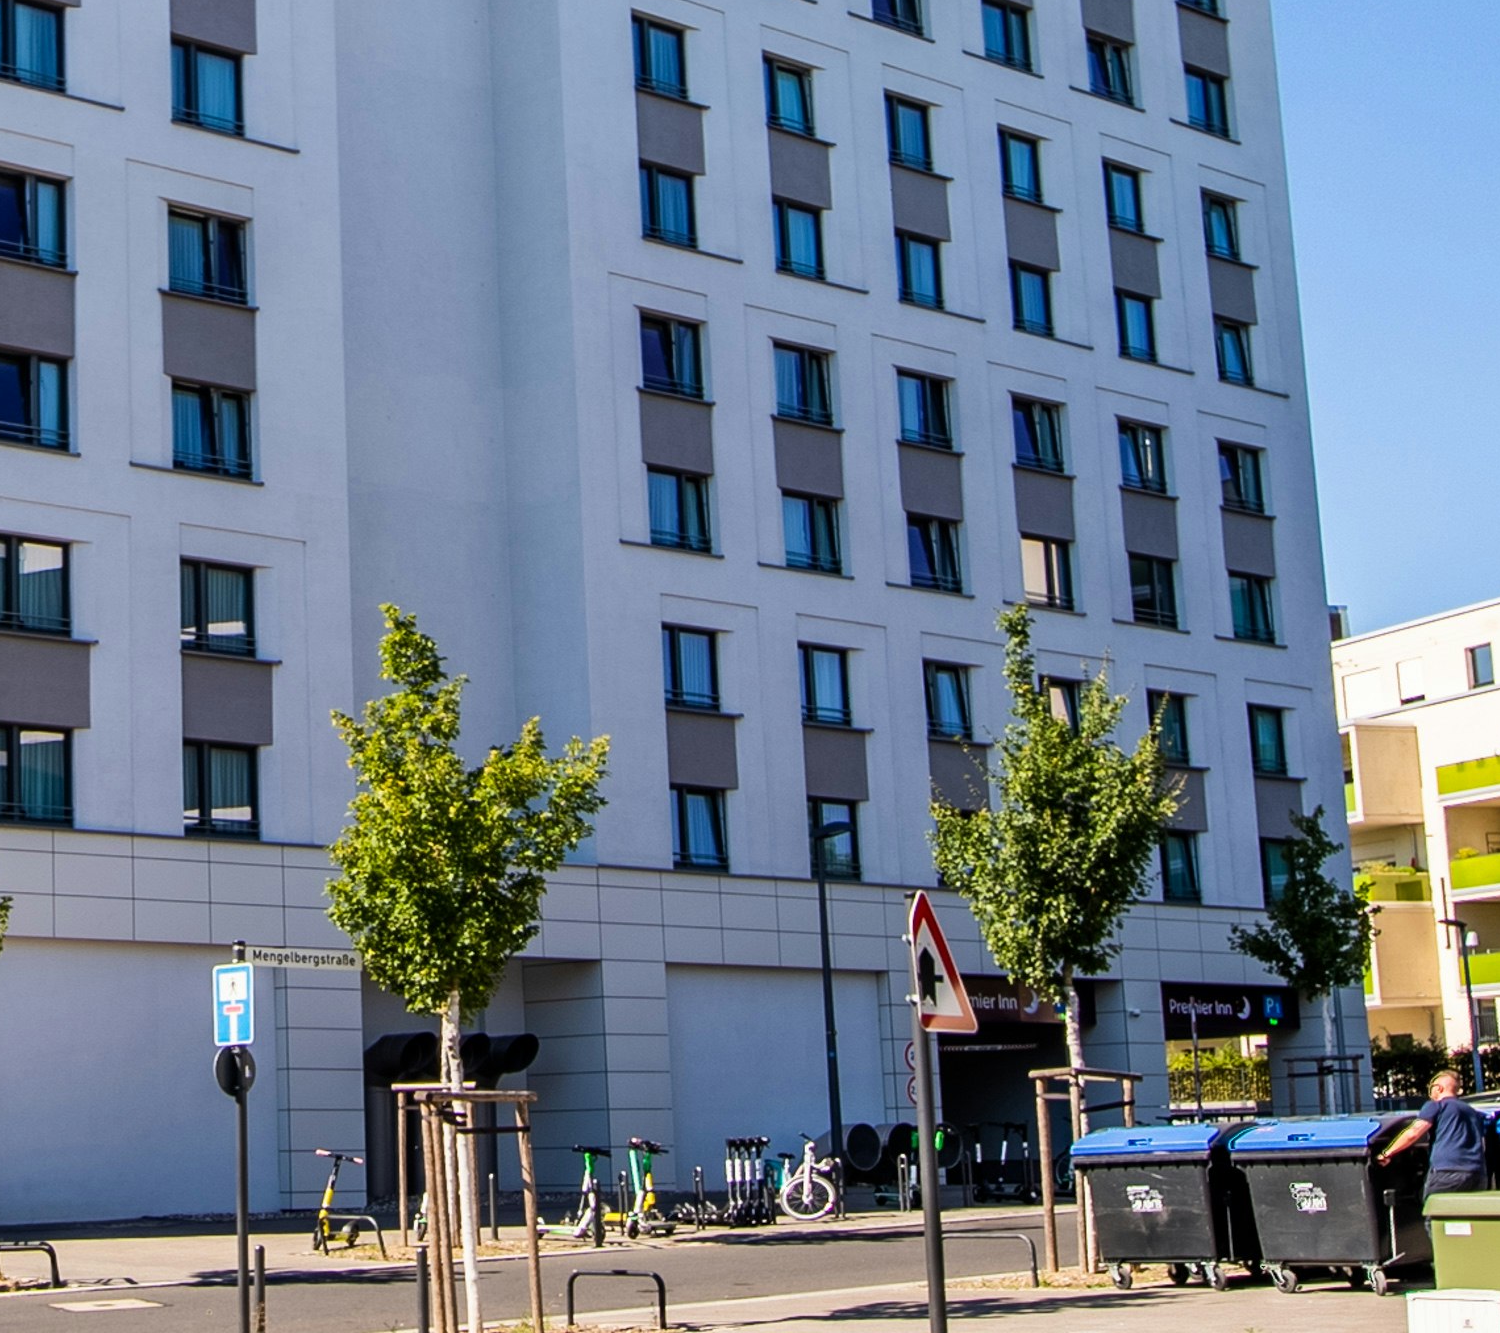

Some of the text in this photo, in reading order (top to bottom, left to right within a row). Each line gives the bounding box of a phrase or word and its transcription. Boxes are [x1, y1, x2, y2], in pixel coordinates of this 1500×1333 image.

[252, 949, 357, 968] Mengelbergstraße
[968, 993, 1019, 1011] mier Inn
[1214, 1000, 1233, 1015] Inn
